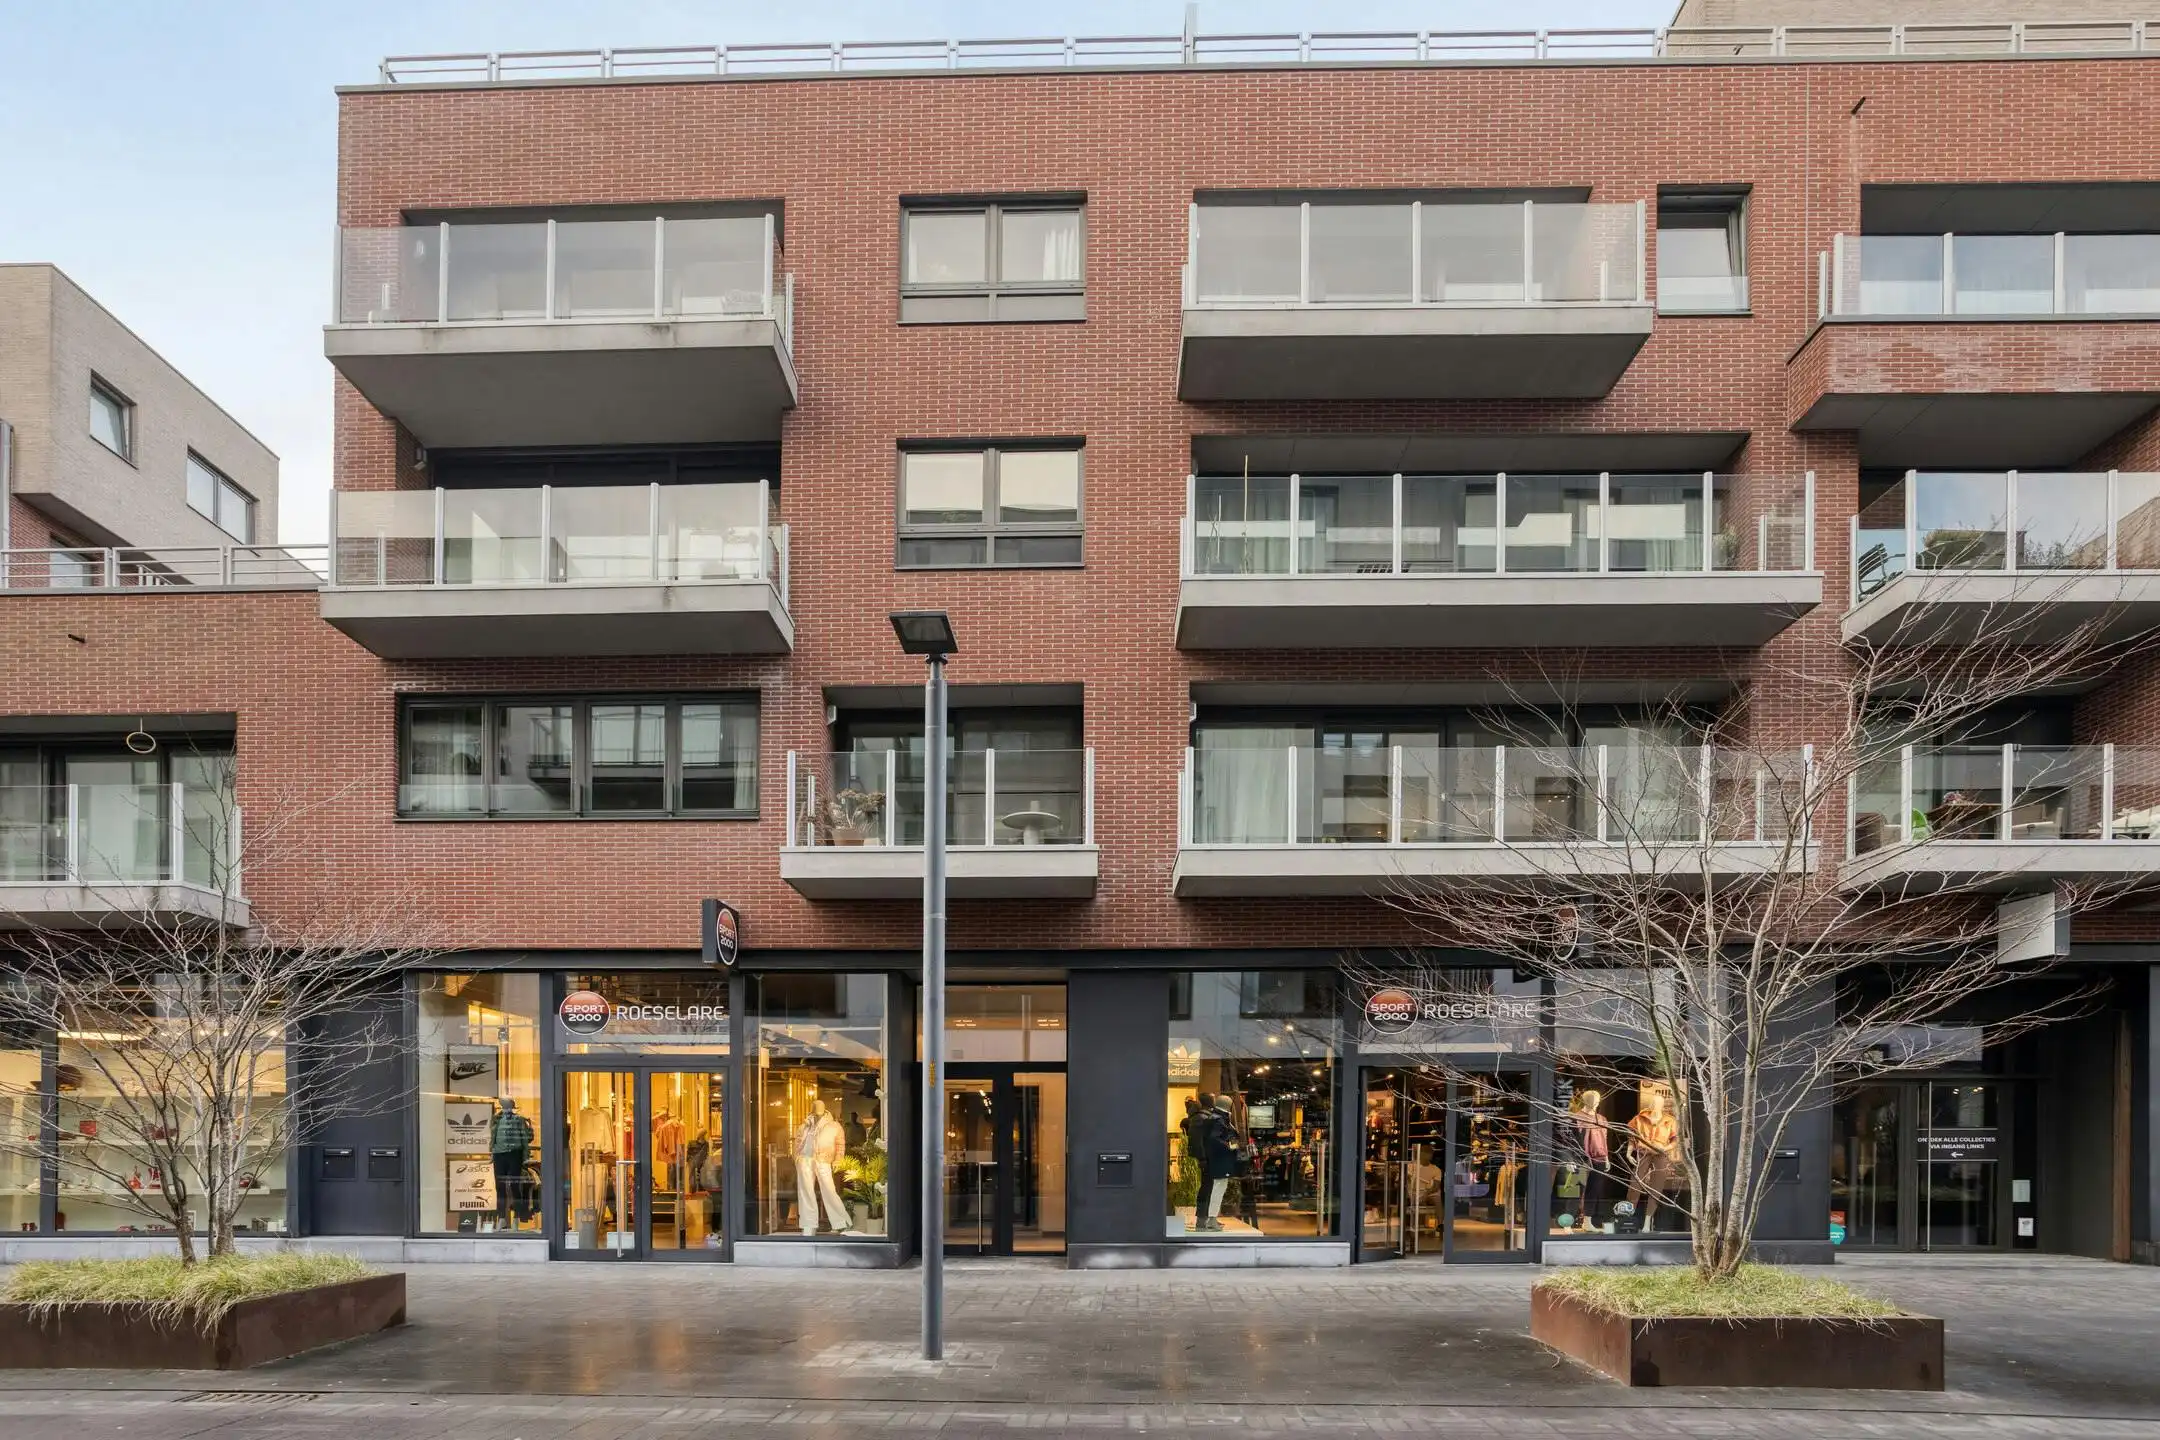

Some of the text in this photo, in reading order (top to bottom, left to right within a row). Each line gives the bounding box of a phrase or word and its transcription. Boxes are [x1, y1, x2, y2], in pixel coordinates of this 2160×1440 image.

[719, 923, 735, 940] SPORT
[720, 935, 734, 949] 2000
[564, 1004, 606, 1013] SPORT
[1371, 1003, 1413, 1012] SPORT
[1424, 1003, 1536, 1019] ROESELARE
[616, 1005, 725, 1021] ROESELARE
[1374, 1012, 1409, 1021] 2000
[568, 1014, 602, 1022] 2000
[447, 1136, 488, 1145] adidas
